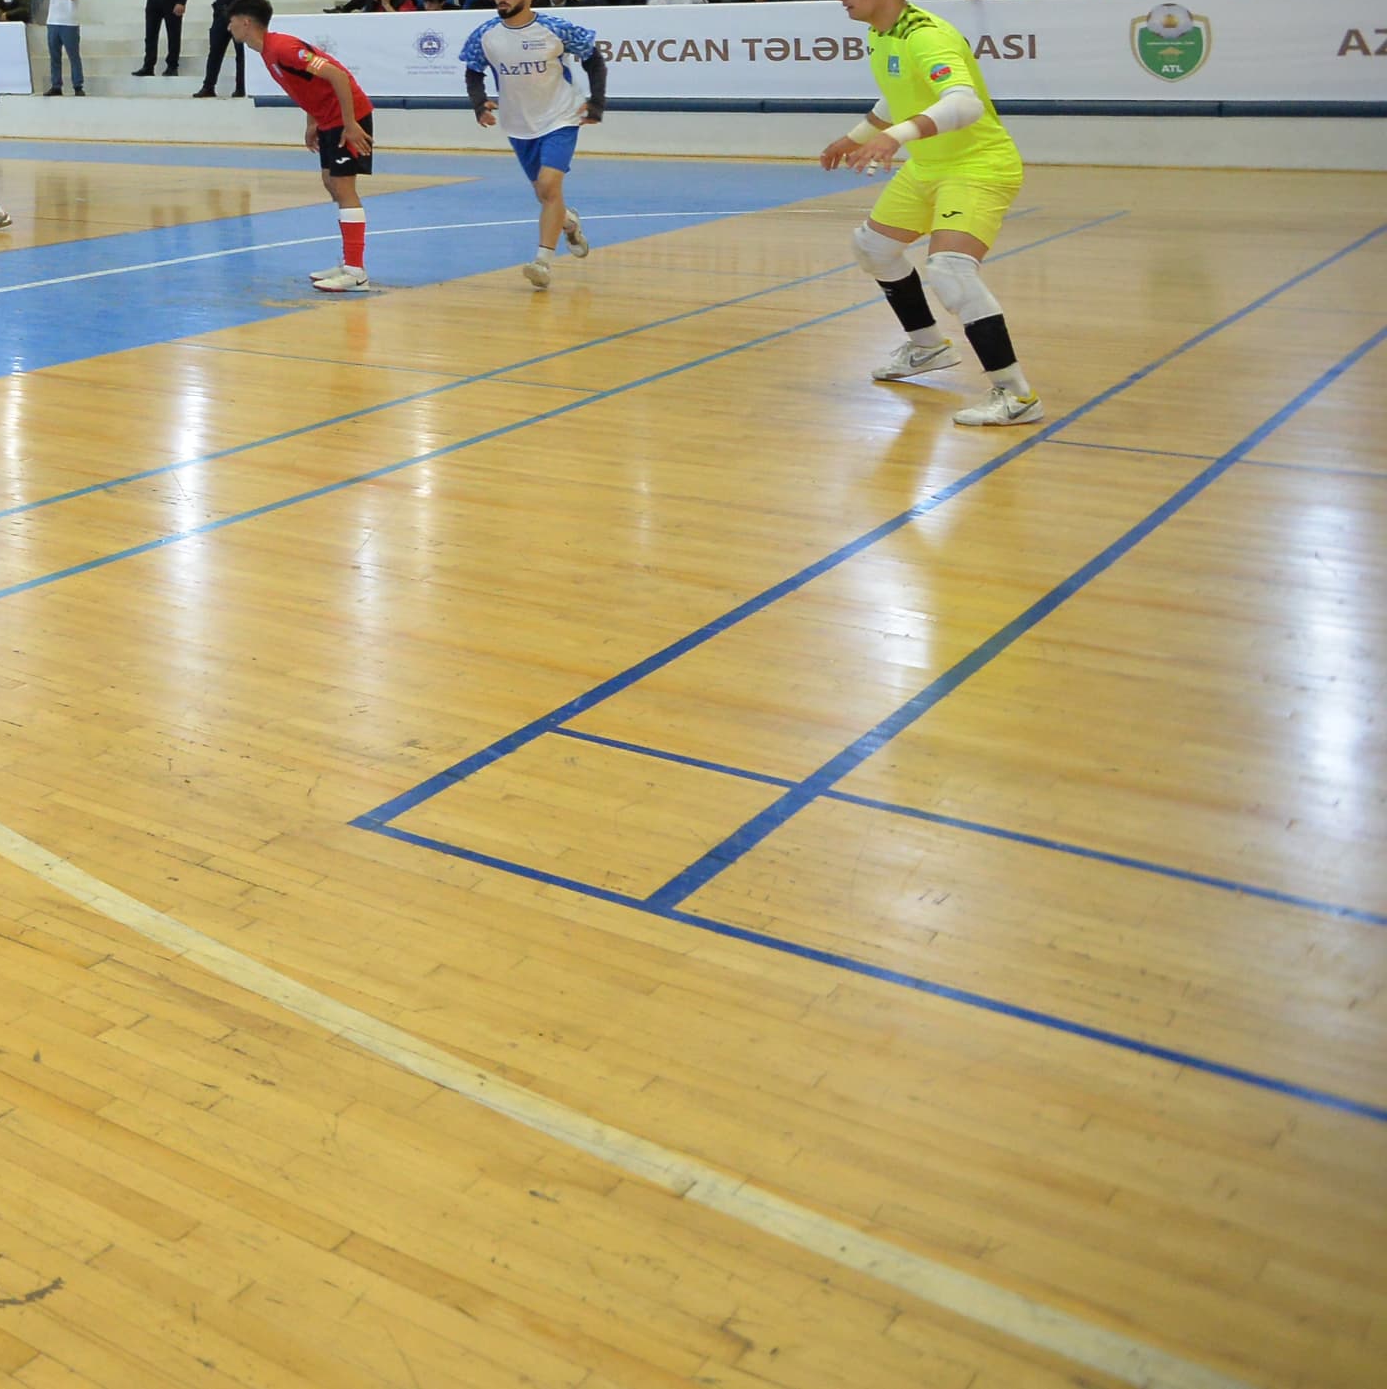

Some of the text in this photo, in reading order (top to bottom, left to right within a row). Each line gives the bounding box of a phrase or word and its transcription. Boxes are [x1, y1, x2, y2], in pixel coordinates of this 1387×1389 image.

[573, 38, 730, 62] BAYCAN
[741, 37, 867, 61] TƏLƏB
[963, 34, 1036, 60] ASI
[498, 60, 548, 76] AzTU
[1161, 64, 1184, 73] ATL
